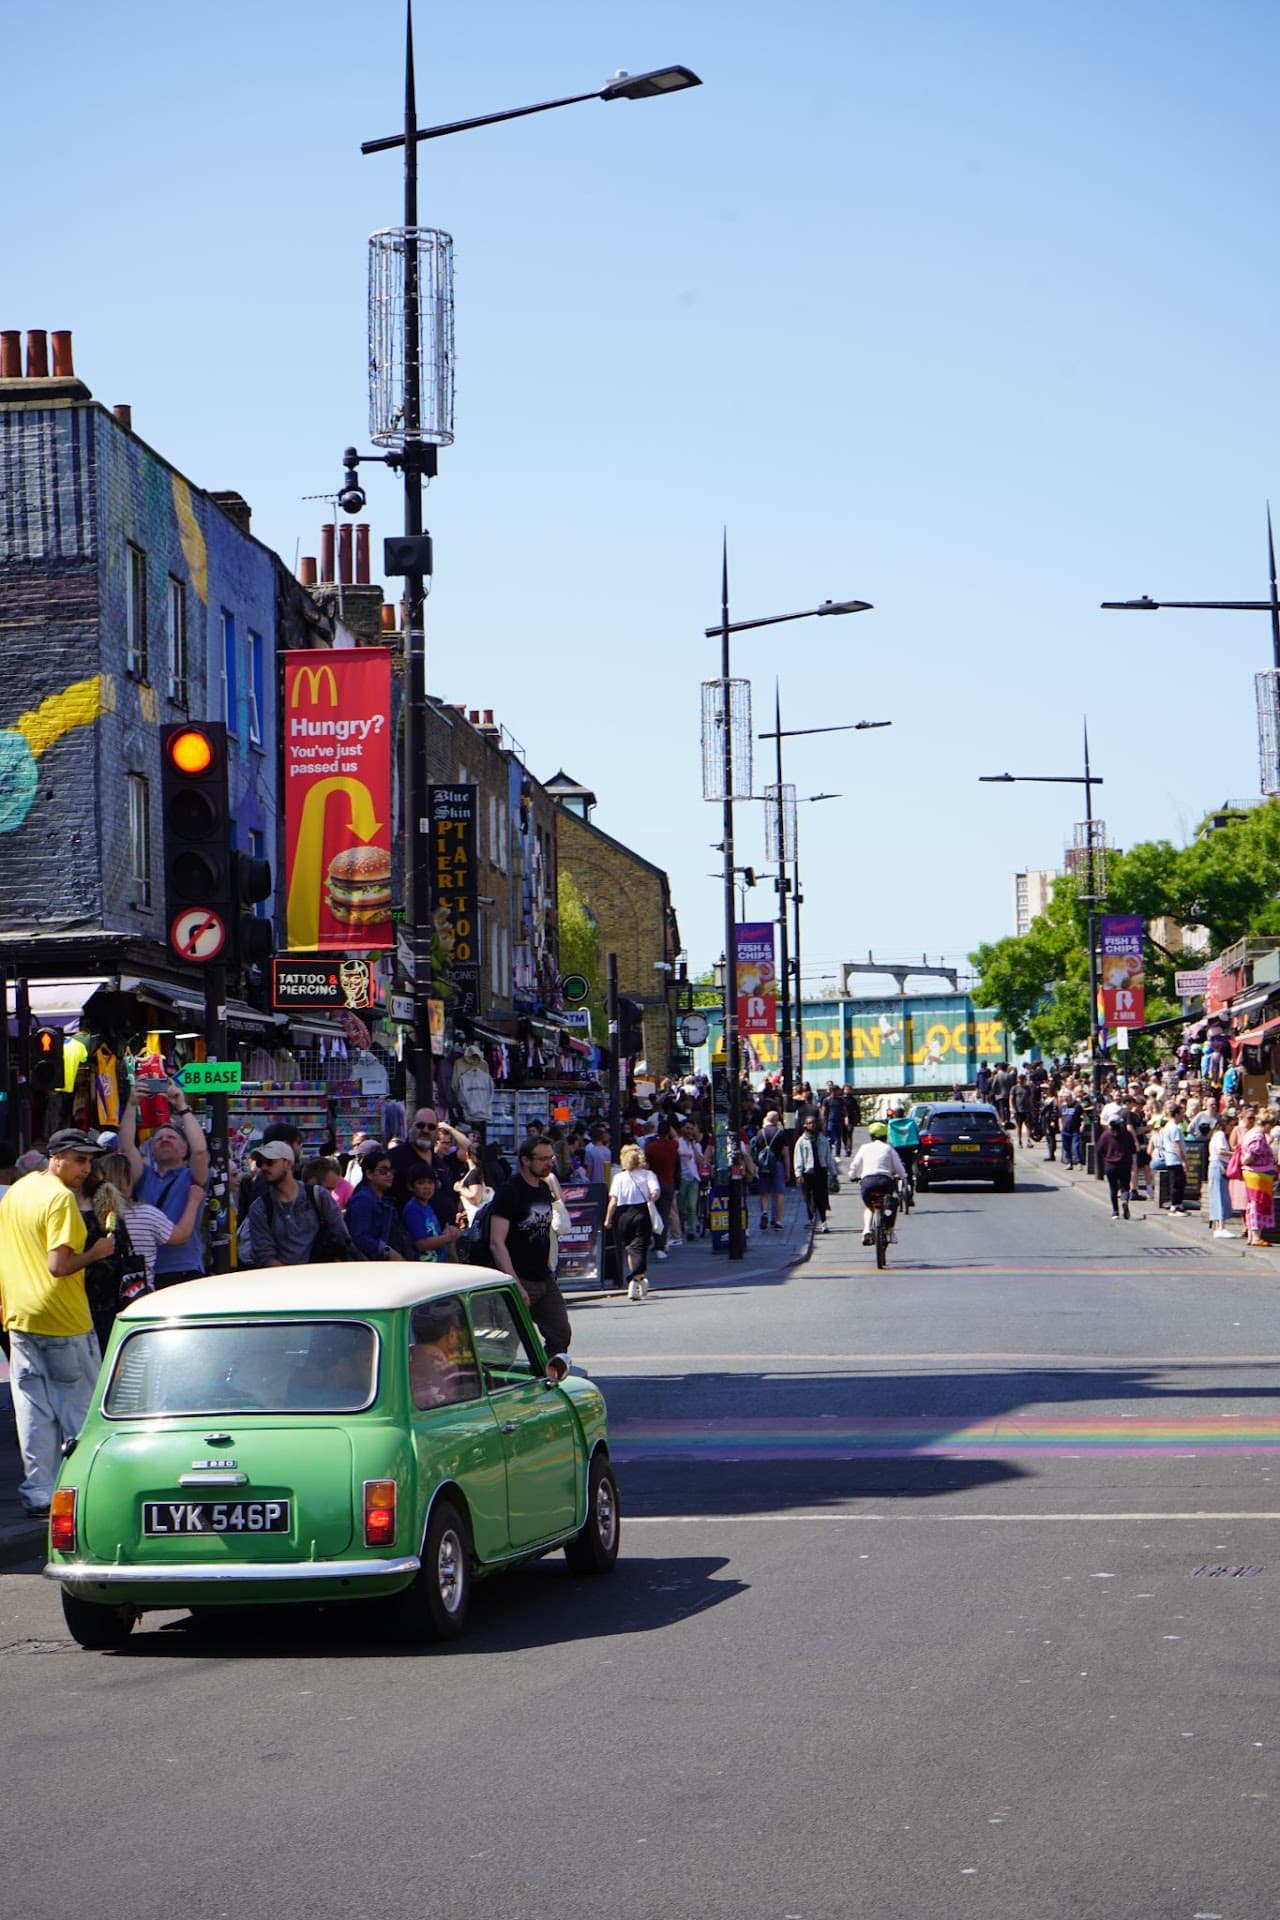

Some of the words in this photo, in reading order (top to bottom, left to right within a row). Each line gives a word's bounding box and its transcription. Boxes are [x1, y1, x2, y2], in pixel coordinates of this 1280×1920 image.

[291, 714, 385, 740] Hungry?
[290, 745, 334, 758] You've
[336, 743, 363, 760] just
[290, 760, 339, 777] passed
[342, 762, 358, 772] us
[433, 789, 470, 803] Blue
[433, 805, 471, 820] Skin
[1104, 937, 1129, 946] FISH
[1131, 937, 1139, 945] &
[737, 944, 762, 953] FISH
[763, 944, 771, 952] &
[1105, 945, 1139, 953] CHIPS
[737, 952, 772, 960] CHIPS
[278, 974, 326, 985] TATTOO
[328, 975, 338, 985] &
[279, 985, 337, 996] PIERCING
[1113, 1011, 1119, 1020] 2
[745, 1019, 751, 1027] 2
[898, 1017, 1003, 1064] LOCK
[184, 1071, 201, 1085] BB
[204, 1070, 238, 1085] BASE
[151, 1505, 203, 1532] LYK
[212, 1503, 281, 1530] 546P
